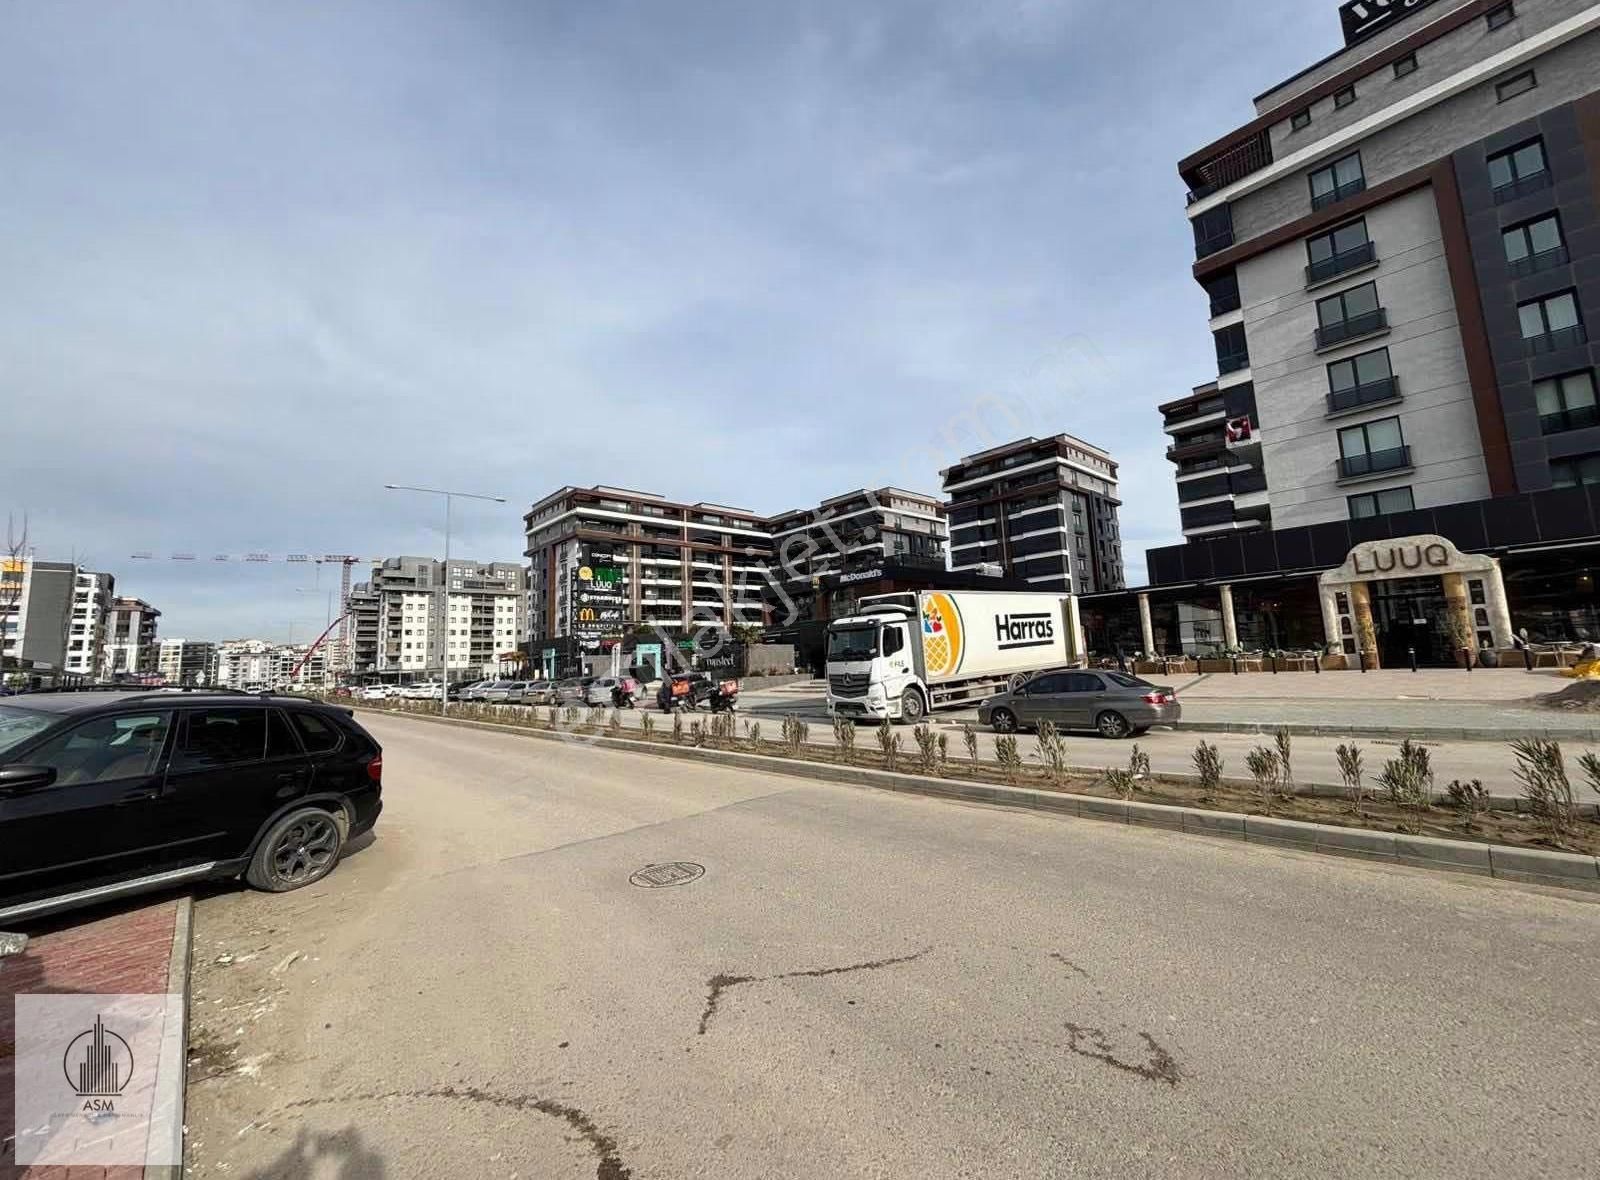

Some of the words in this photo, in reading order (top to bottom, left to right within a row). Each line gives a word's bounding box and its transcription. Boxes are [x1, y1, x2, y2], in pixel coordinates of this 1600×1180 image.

[1353, 544, 1449, 574] LUUQ
[839, 568, 882, 583] McDonald's
[995, 613, 1054, 642] Harras
